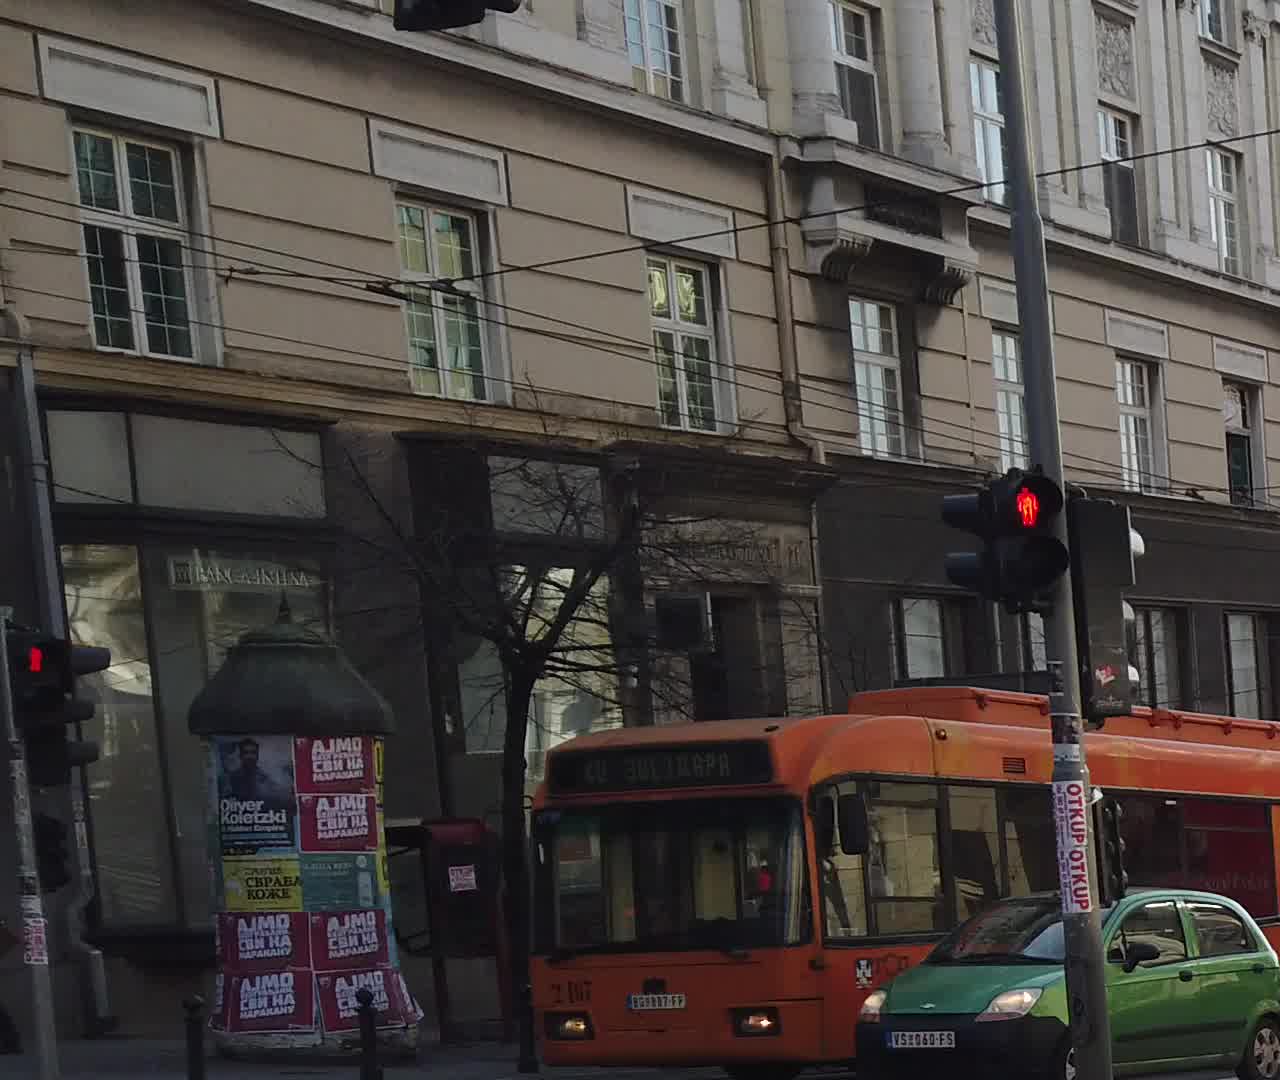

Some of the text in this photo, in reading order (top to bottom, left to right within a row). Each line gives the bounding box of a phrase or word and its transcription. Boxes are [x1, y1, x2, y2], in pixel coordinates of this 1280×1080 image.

[220, 798, 265, 812] Oliver
[220, 809, 287, 825] Koletzki
[1066, 783, 1086, 844] OTKUP
[1068, 849, 1089, 911] OTKUP
[247, 888, 291, 900] КОЖЕ
